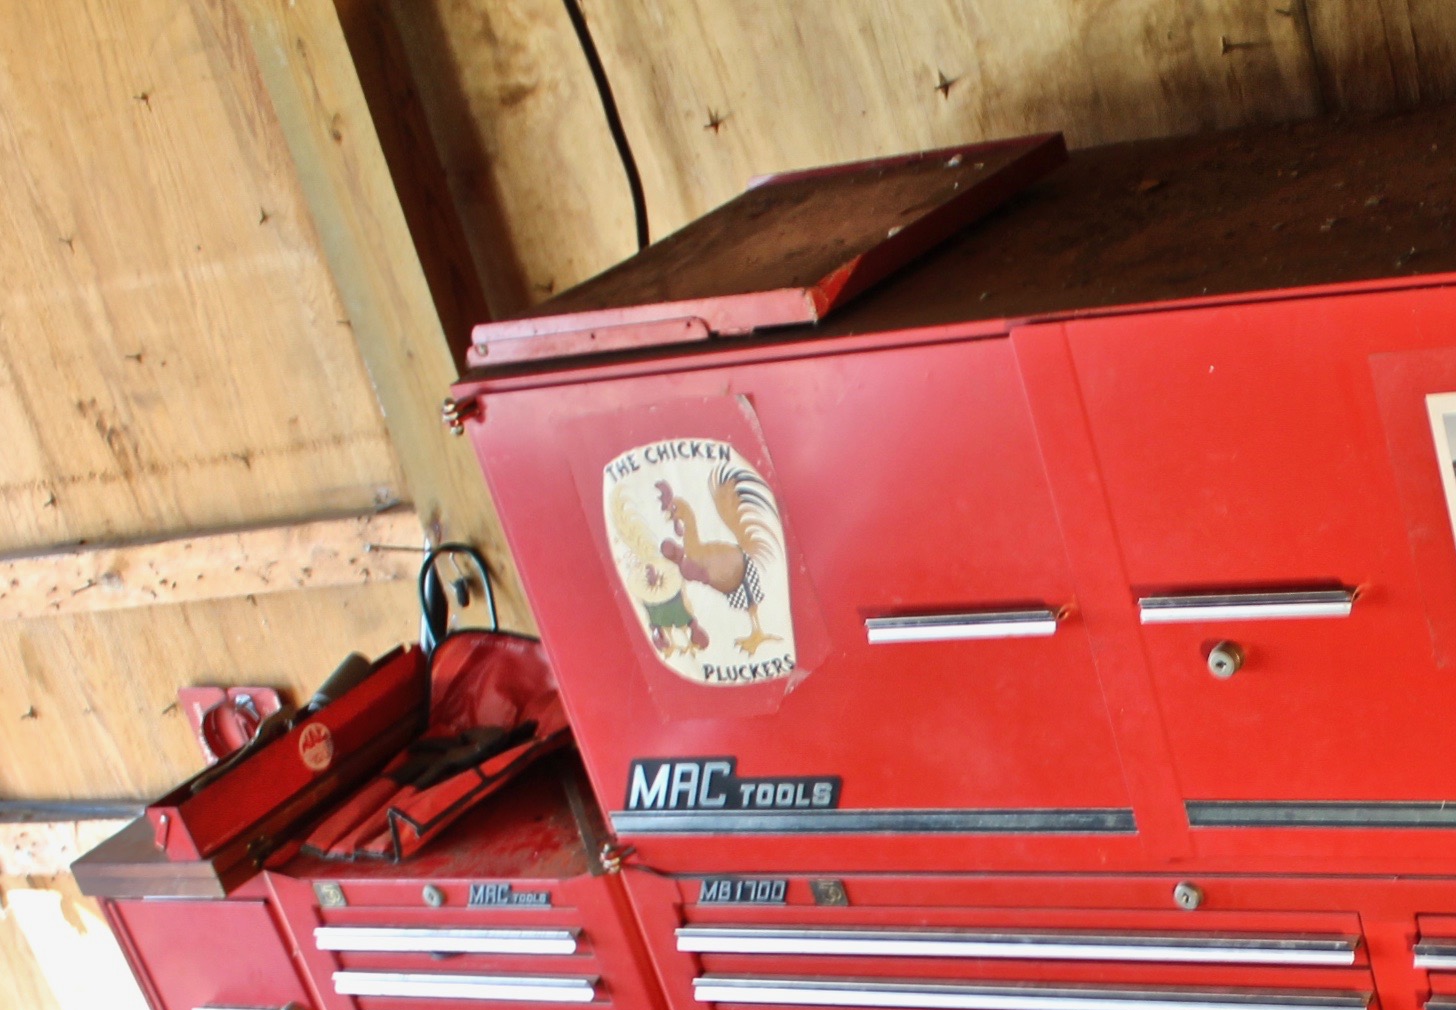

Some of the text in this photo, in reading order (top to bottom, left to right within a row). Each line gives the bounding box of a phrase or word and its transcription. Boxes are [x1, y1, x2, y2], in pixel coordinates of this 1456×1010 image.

[606, 440, 731, 482] THE CHICKEN
[703, 653, 796, 681] PLUCKERS
[629, 761, 834, 809] MAC TOOLS
[470, 883, 548, 905] MAC TOOLS
